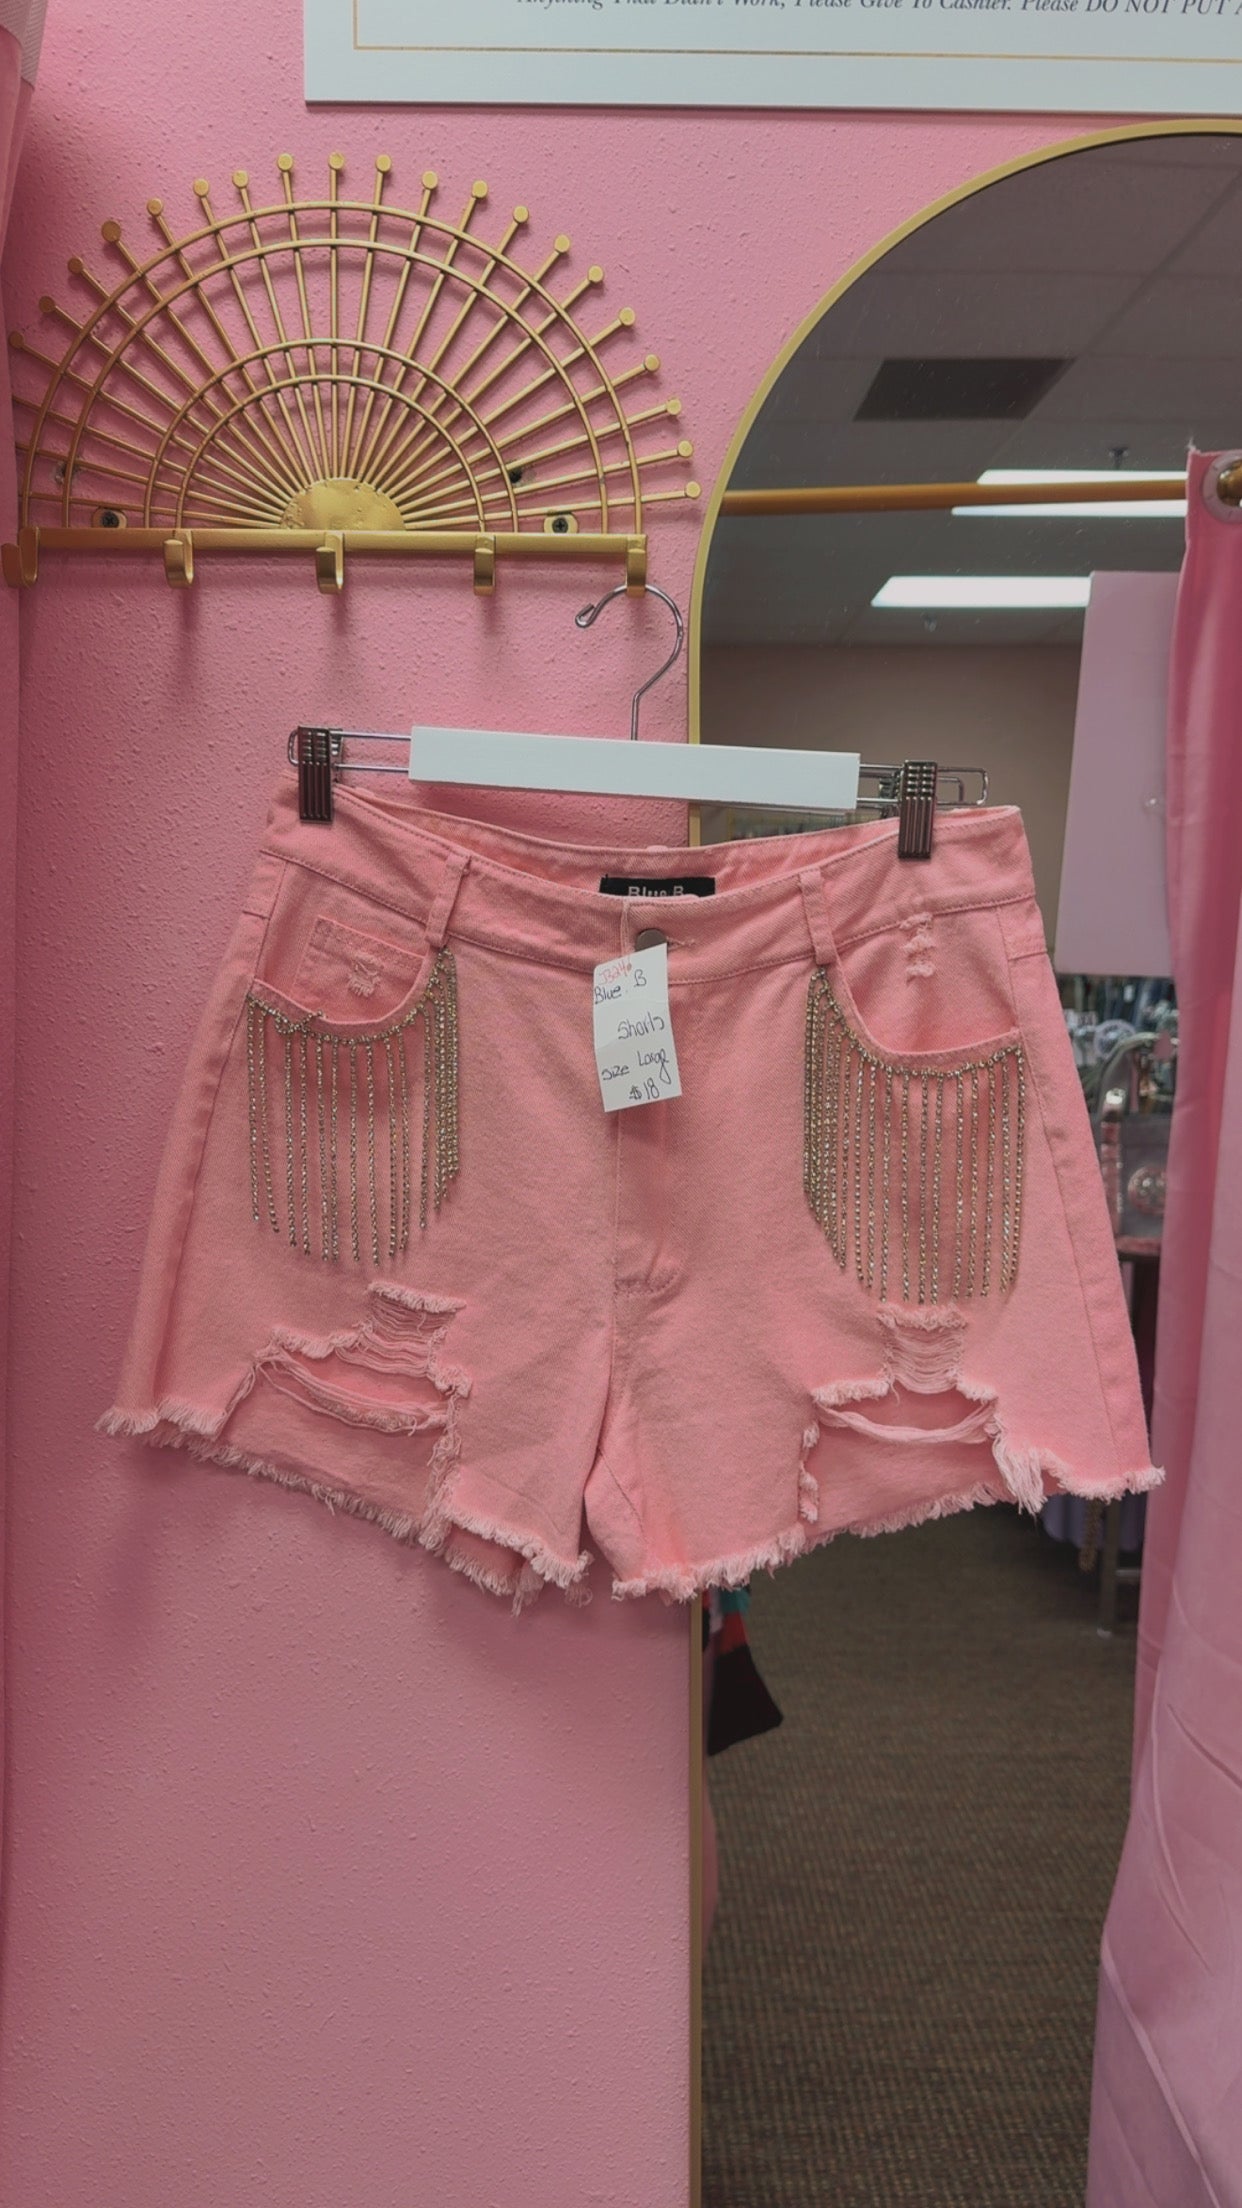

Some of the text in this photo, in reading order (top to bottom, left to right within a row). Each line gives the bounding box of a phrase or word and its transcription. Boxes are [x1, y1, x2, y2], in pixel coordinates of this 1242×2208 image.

[940, 0, 1011, 10] Cashier.
[1021, 0, 1079, 11] Please
[1085, 0, 1119, 12] DO
[1124, 0, 1176, 13] NOT
[1182, 0, 1231, 15] PUT
[594, 969, 647, 1005] Blue B
[617, 1011, 665, 1039] Shorts
[629, 1077, 660, 1100] $18
